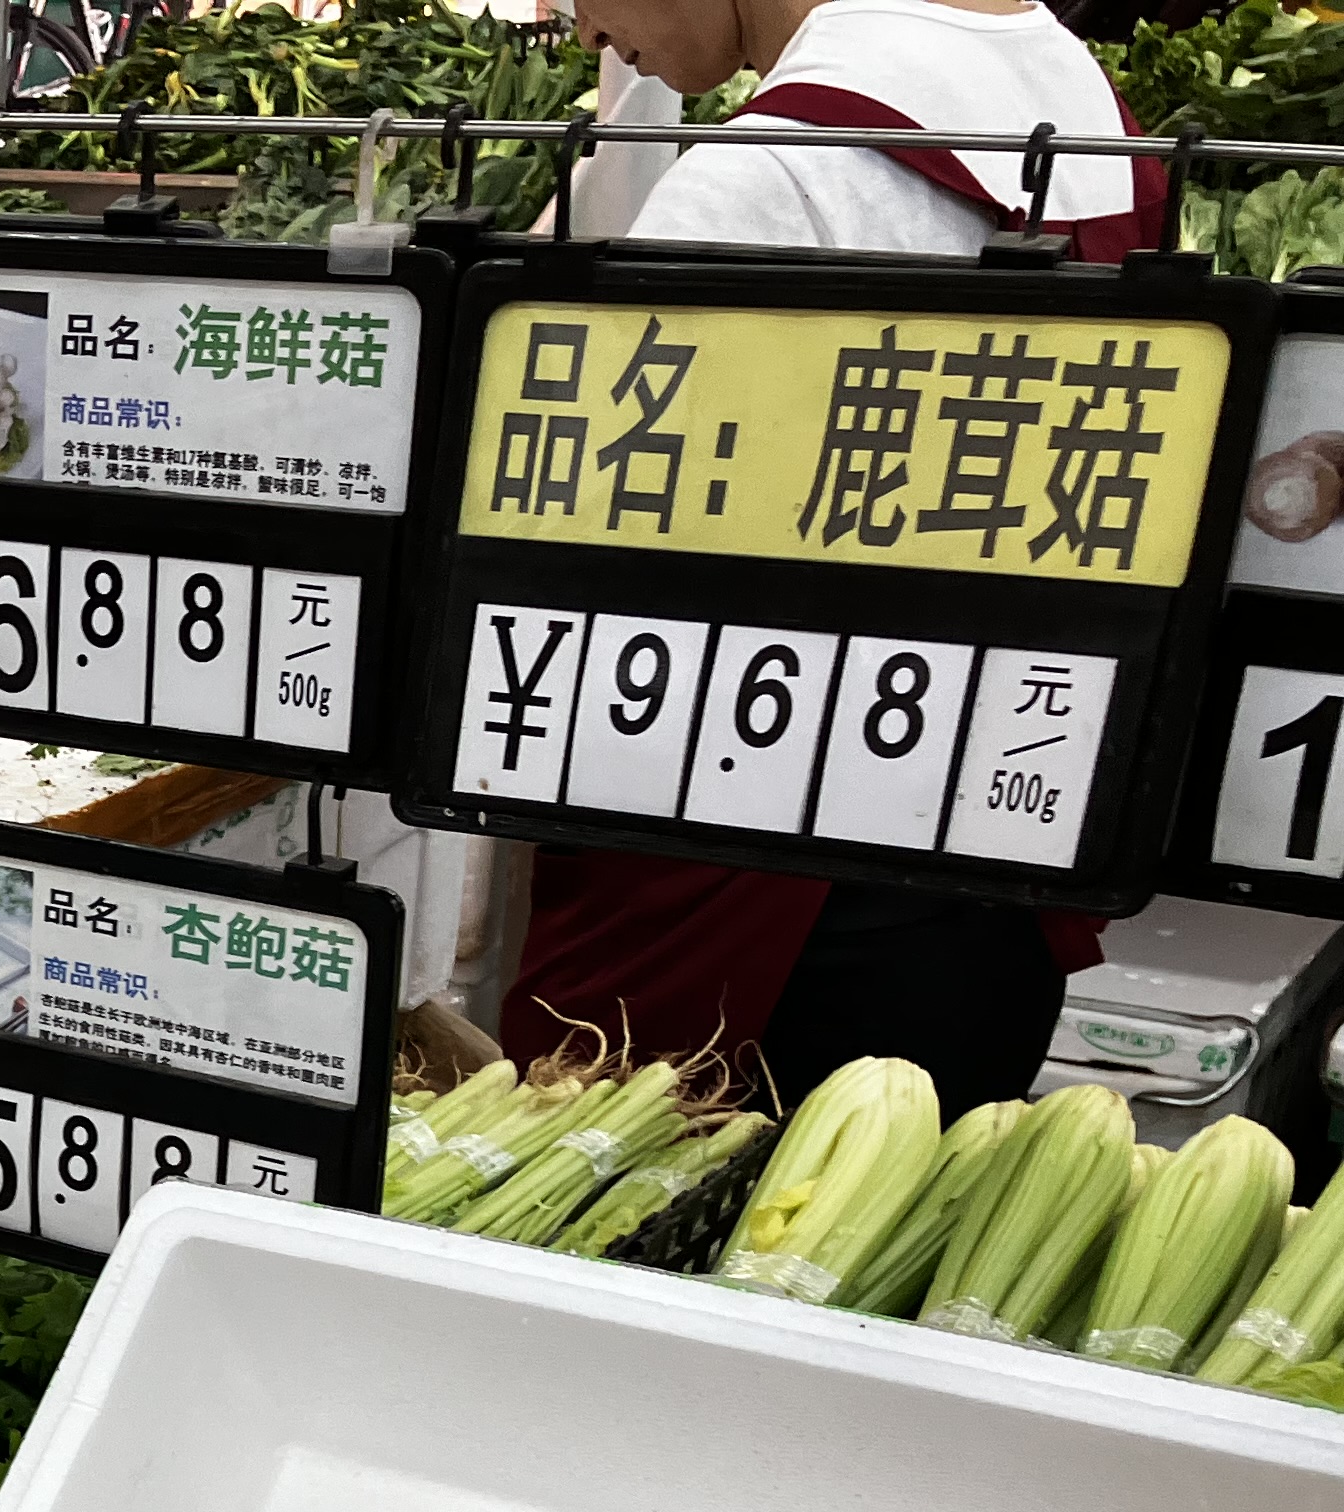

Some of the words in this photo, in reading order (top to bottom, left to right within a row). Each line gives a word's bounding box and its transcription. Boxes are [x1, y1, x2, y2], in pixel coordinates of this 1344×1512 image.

[61, 314, 157, 363] 品名：
[174, 302, 391, 389] 海鲜菇
[490, 315, 740, 535] 品名：
[798, 325, 1182, 572] 鹿茸菇
[162, 904, 355, 993] 杏鲍菇
